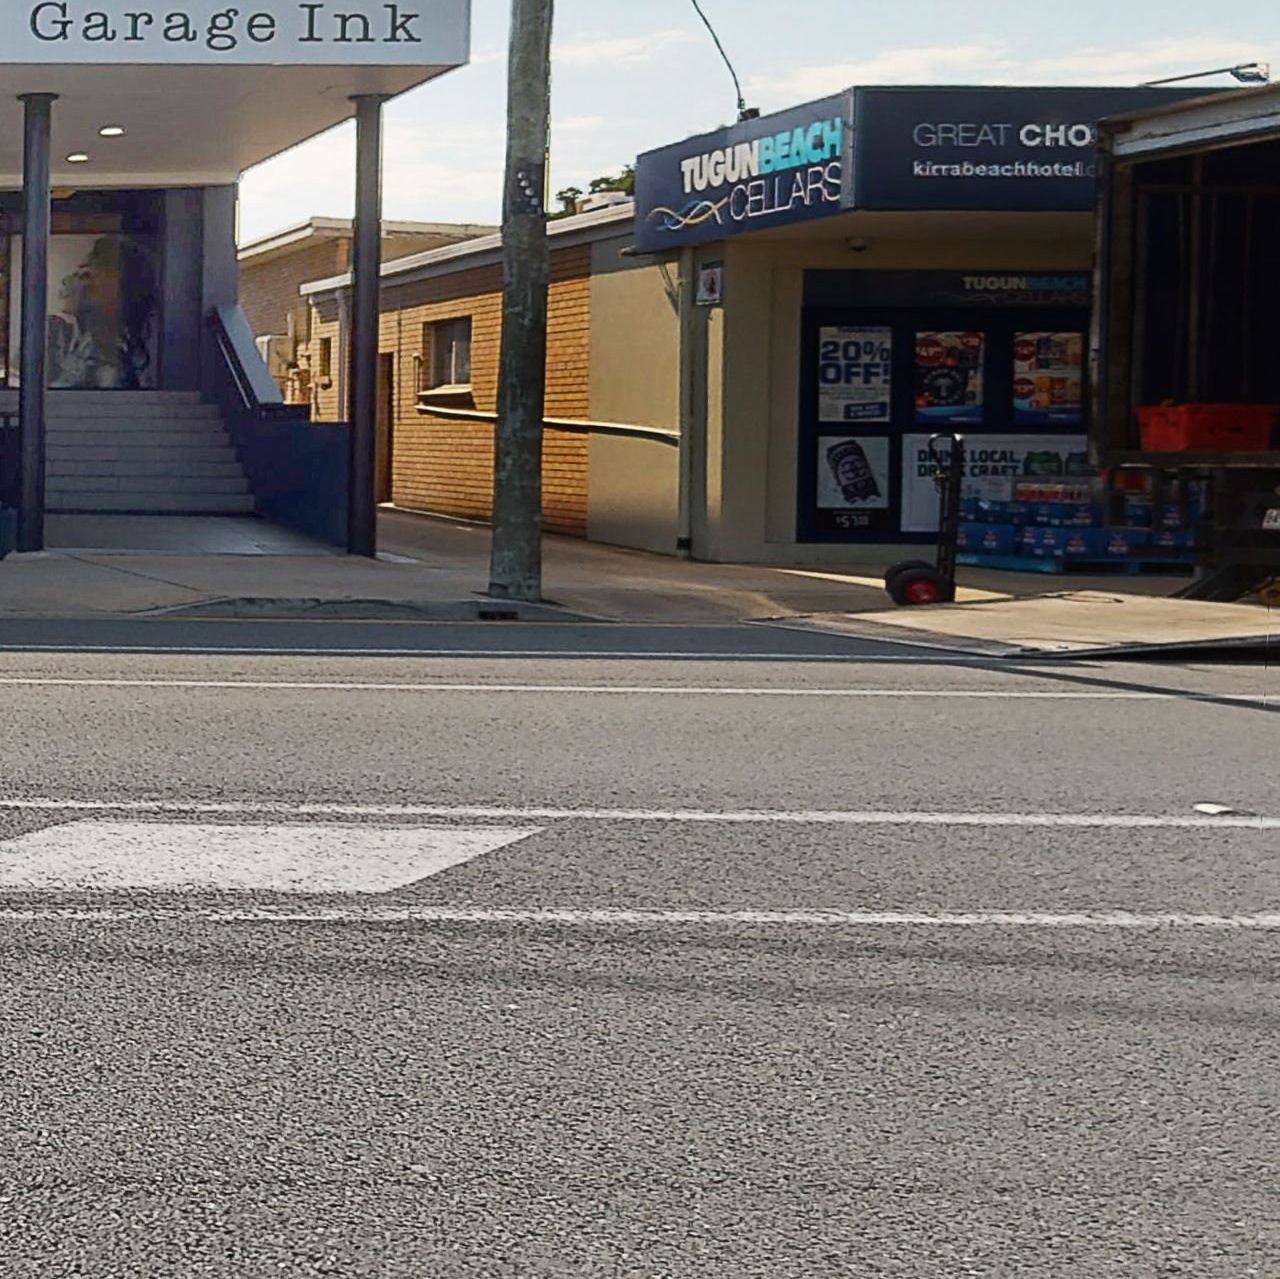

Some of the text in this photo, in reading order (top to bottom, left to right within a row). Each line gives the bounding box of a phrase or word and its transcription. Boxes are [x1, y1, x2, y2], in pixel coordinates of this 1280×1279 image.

[29, 0, 423, 52] Garage Ink
[913, 123, 1096, 147] GREAT CHO
[729, 161, 842, 221] CELLARS
[821, 340, 890, 362] 20%
[819, 362, 890, 384] OFF!
